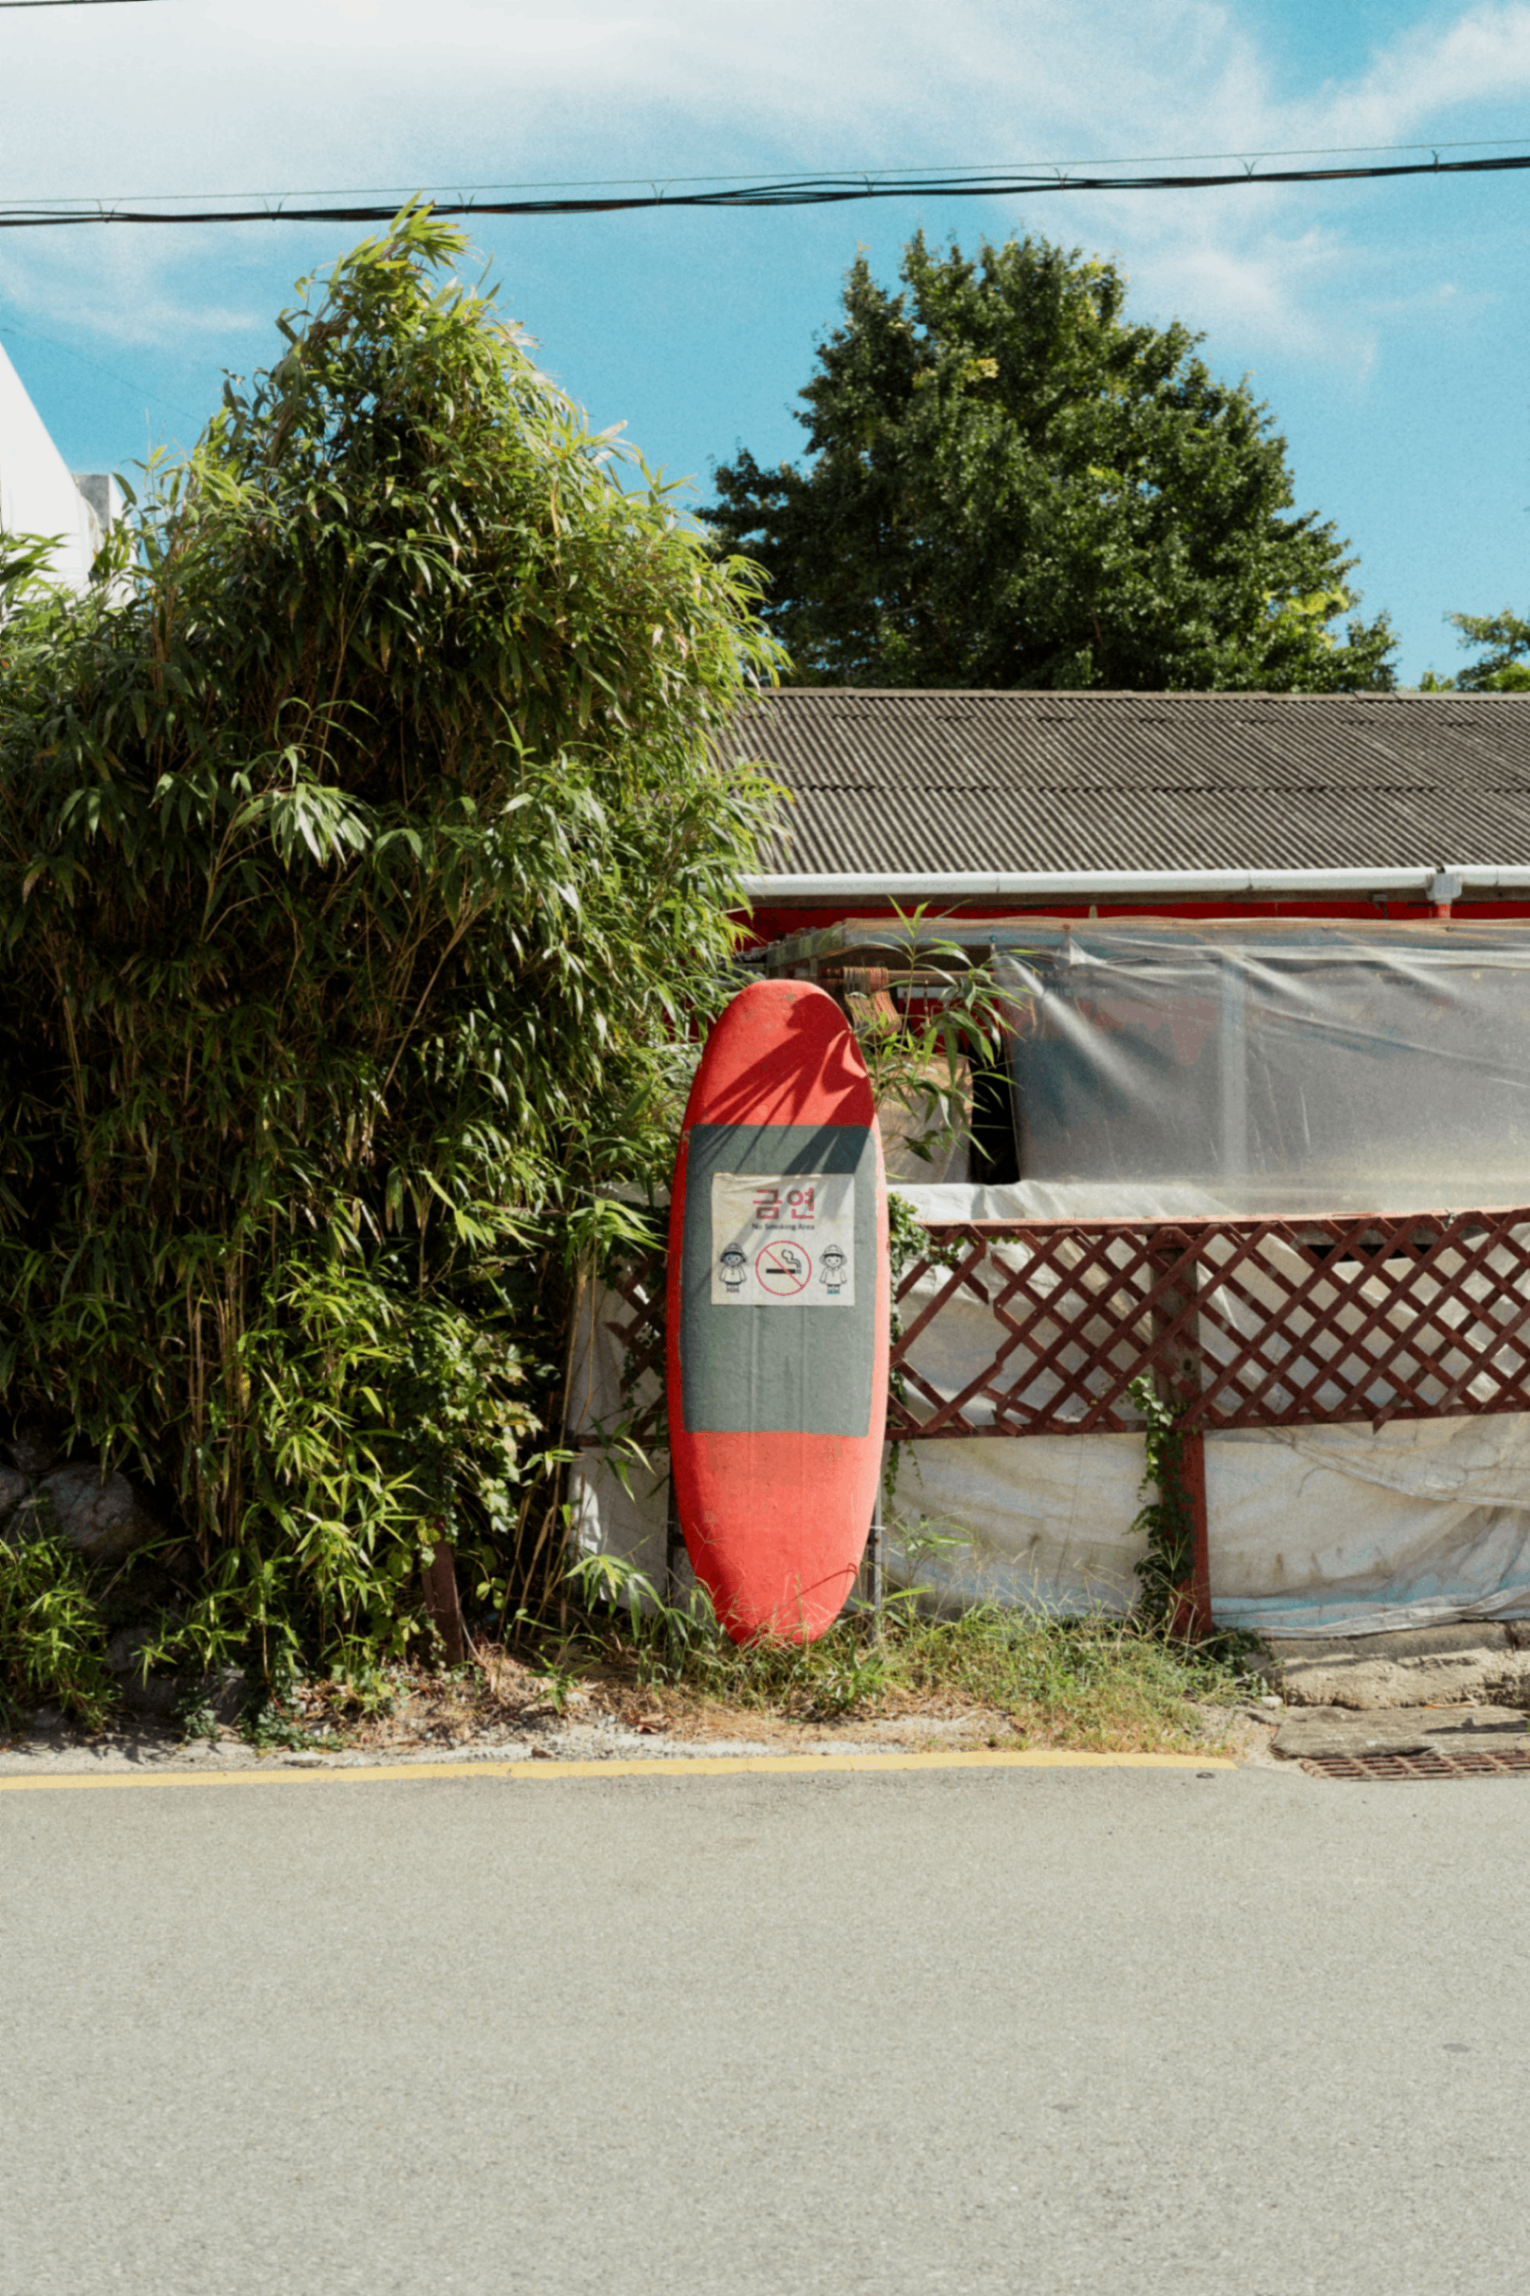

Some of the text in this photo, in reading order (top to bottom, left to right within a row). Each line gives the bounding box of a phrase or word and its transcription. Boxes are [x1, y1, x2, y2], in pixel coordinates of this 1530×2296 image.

[752, 1187, 815, 1220] 금연
[752, 1223, 815, 1232] No Smoking Area
